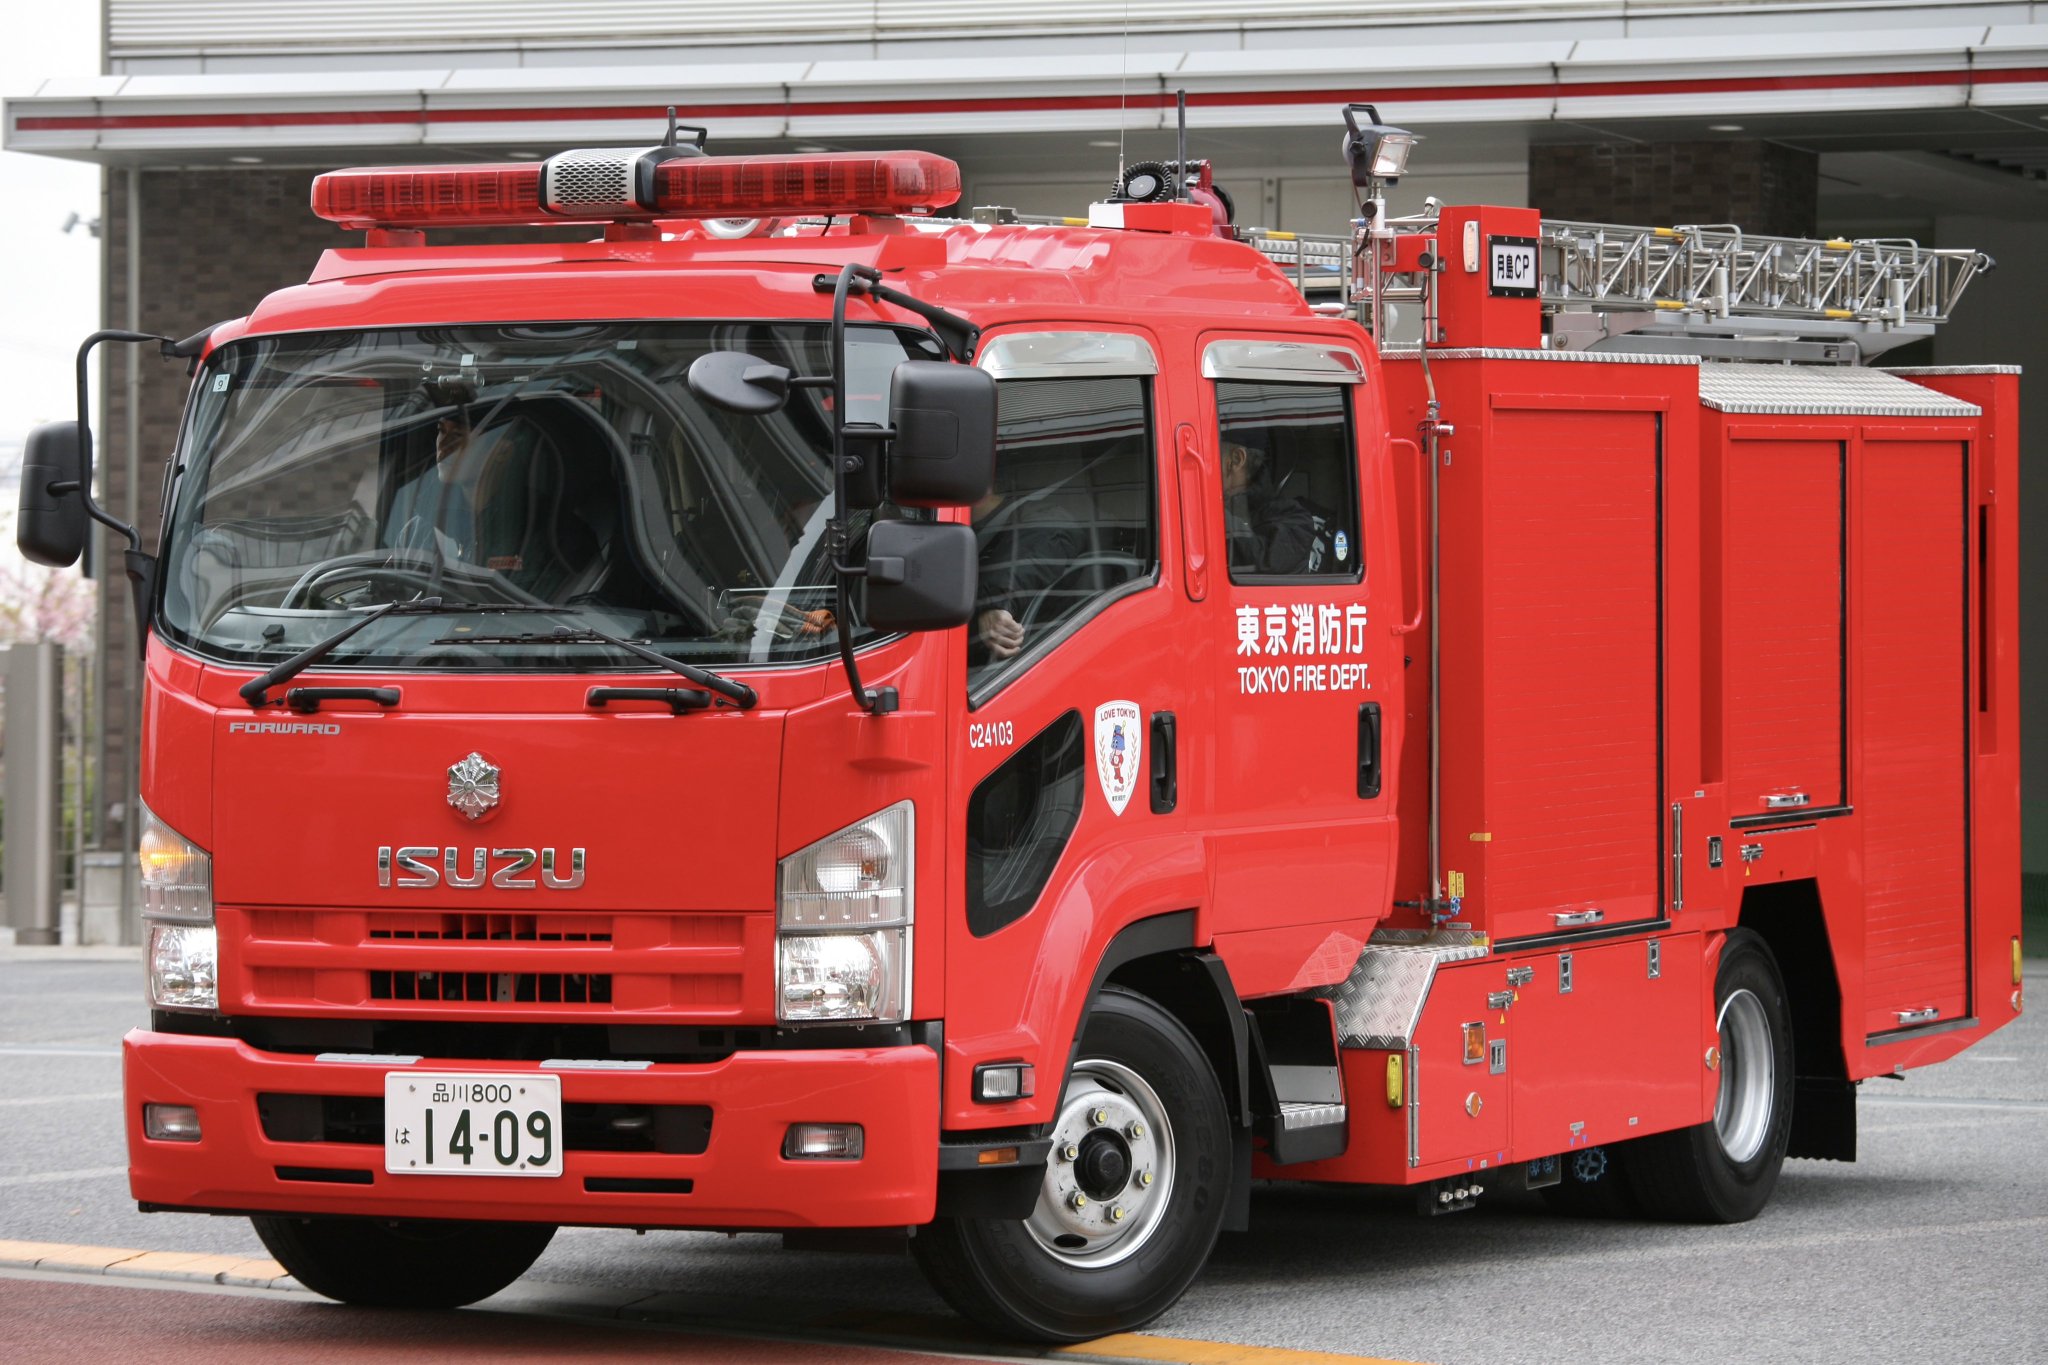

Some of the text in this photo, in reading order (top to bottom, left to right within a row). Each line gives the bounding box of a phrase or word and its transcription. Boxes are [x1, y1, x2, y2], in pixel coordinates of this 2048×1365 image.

[1235, 603, 1367, 656] 東京消防庁
[1238, 663, 1371, 694] TOKYO FIRE DEPT.
[229, 722, 341, 735] FORWARD
[1100, 708, 1136, 721] LOVE TOKYO
[970, 721, 1013, 748] C24103
[377, 846, 585, 889] ISUZU
[395, 1127, 410, 1144] は
[425, 1108, 552, 1166] 14-09
